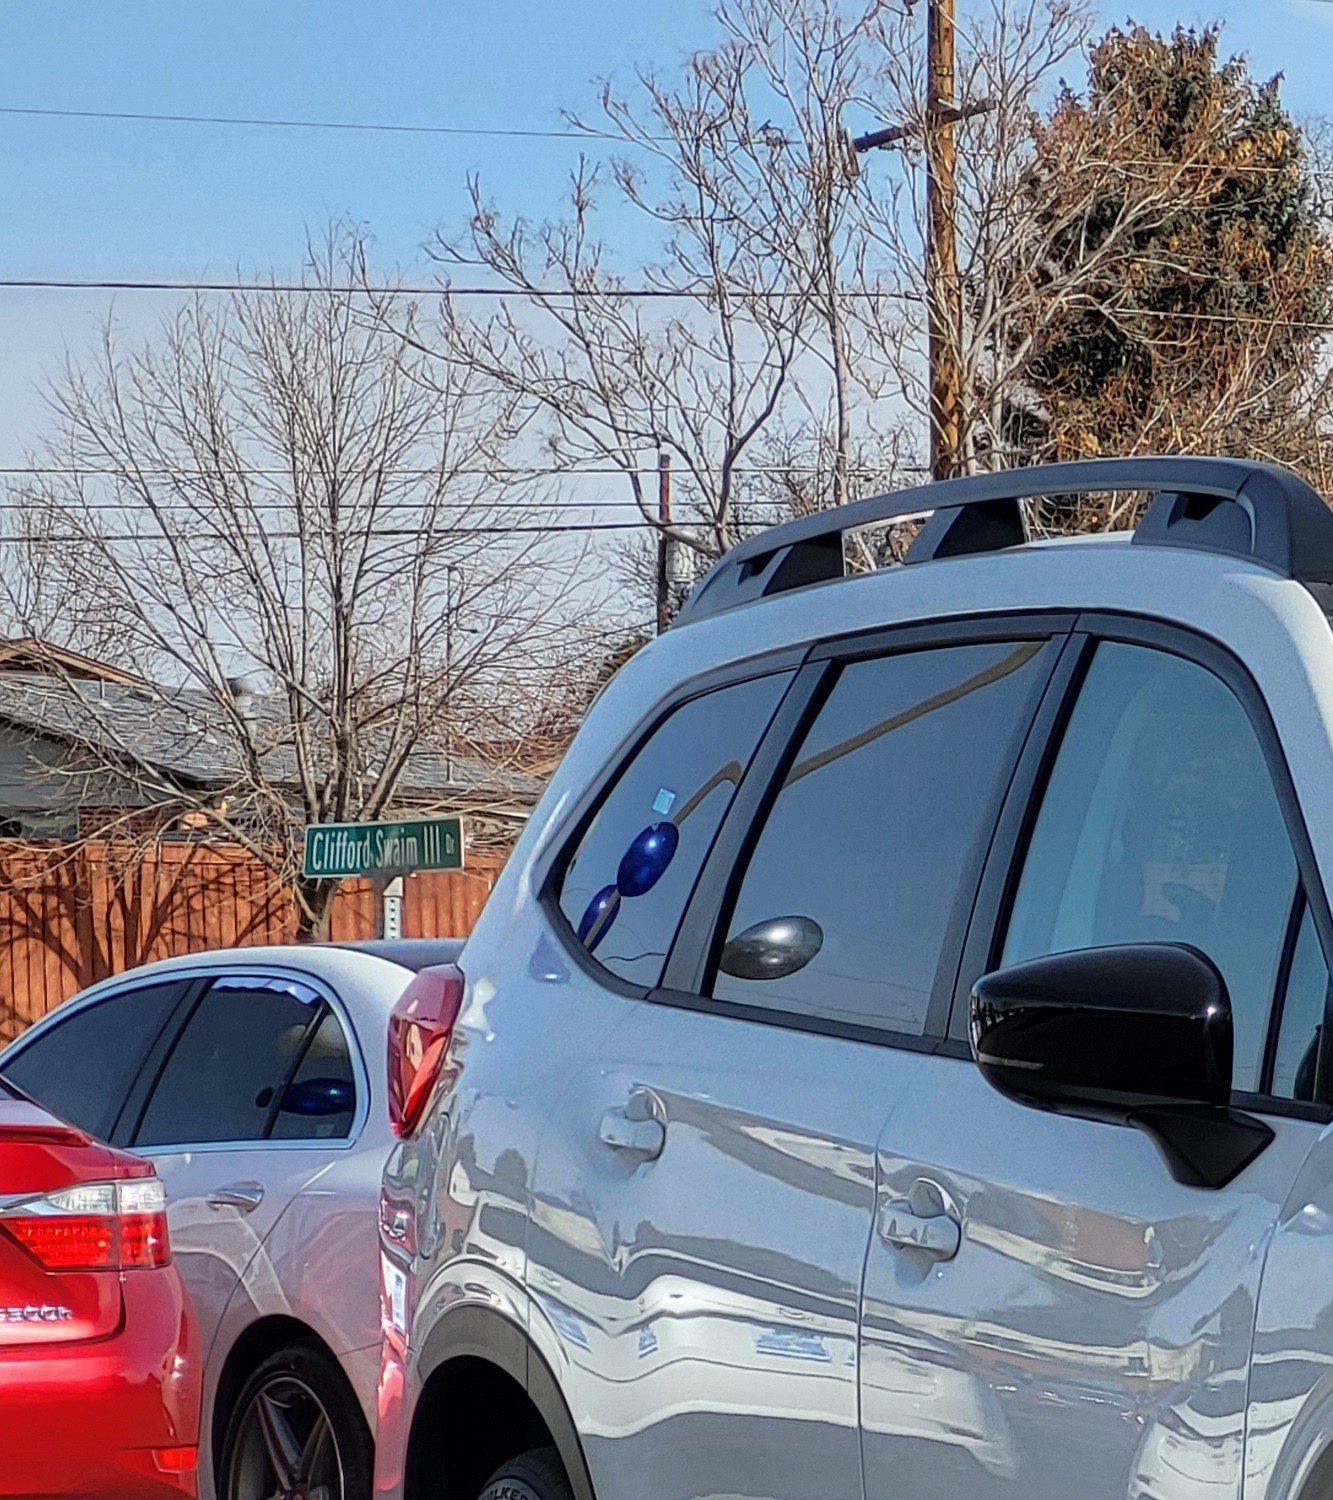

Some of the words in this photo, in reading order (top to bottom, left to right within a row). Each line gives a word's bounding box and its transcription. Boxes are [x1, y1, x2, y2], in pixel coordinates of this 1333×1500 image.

[312, 831, 370, 871] Clifford
[375, 828, 418, 868] Swaim
[423, 825, 440, 864] III
